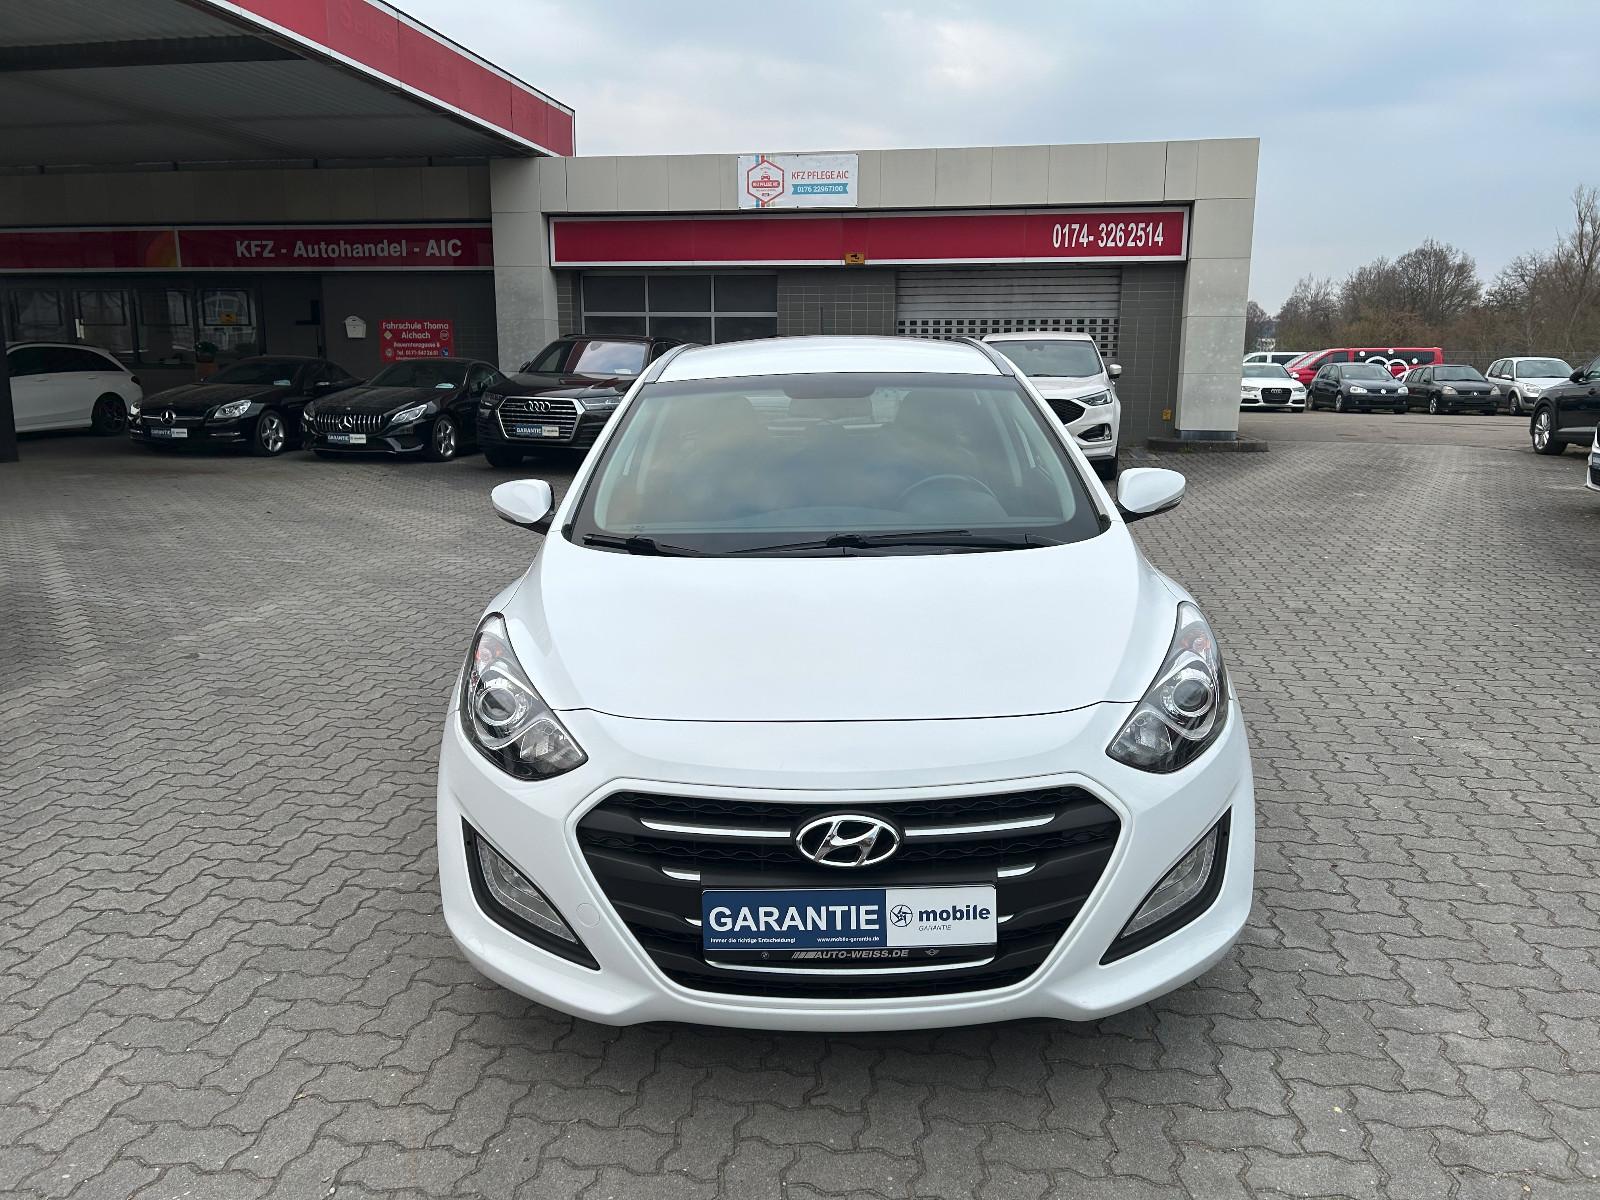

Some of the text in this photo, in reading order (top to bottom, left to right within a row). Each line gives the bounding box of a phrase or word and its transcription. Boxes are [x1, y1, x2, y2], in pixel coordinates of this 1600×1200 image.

[791, 170, 849, 180] KFZ PFLEGE AIC
[797, 185, 813, 193] 0176
[236, 240, 276, 258] KFZ
[293, 239, 407, 258] Autohandel
[425, 239, 463, 257] AIC
[382, 321, 449, 330] Fahrschule Thoma
[401, 330, 431, 339] Aichach
[708, 904, 880, 932] GARANTIE
[918, 904, 991, 922] mobile
[814, 949, 910, 959] AUTO-WEISS.DE
